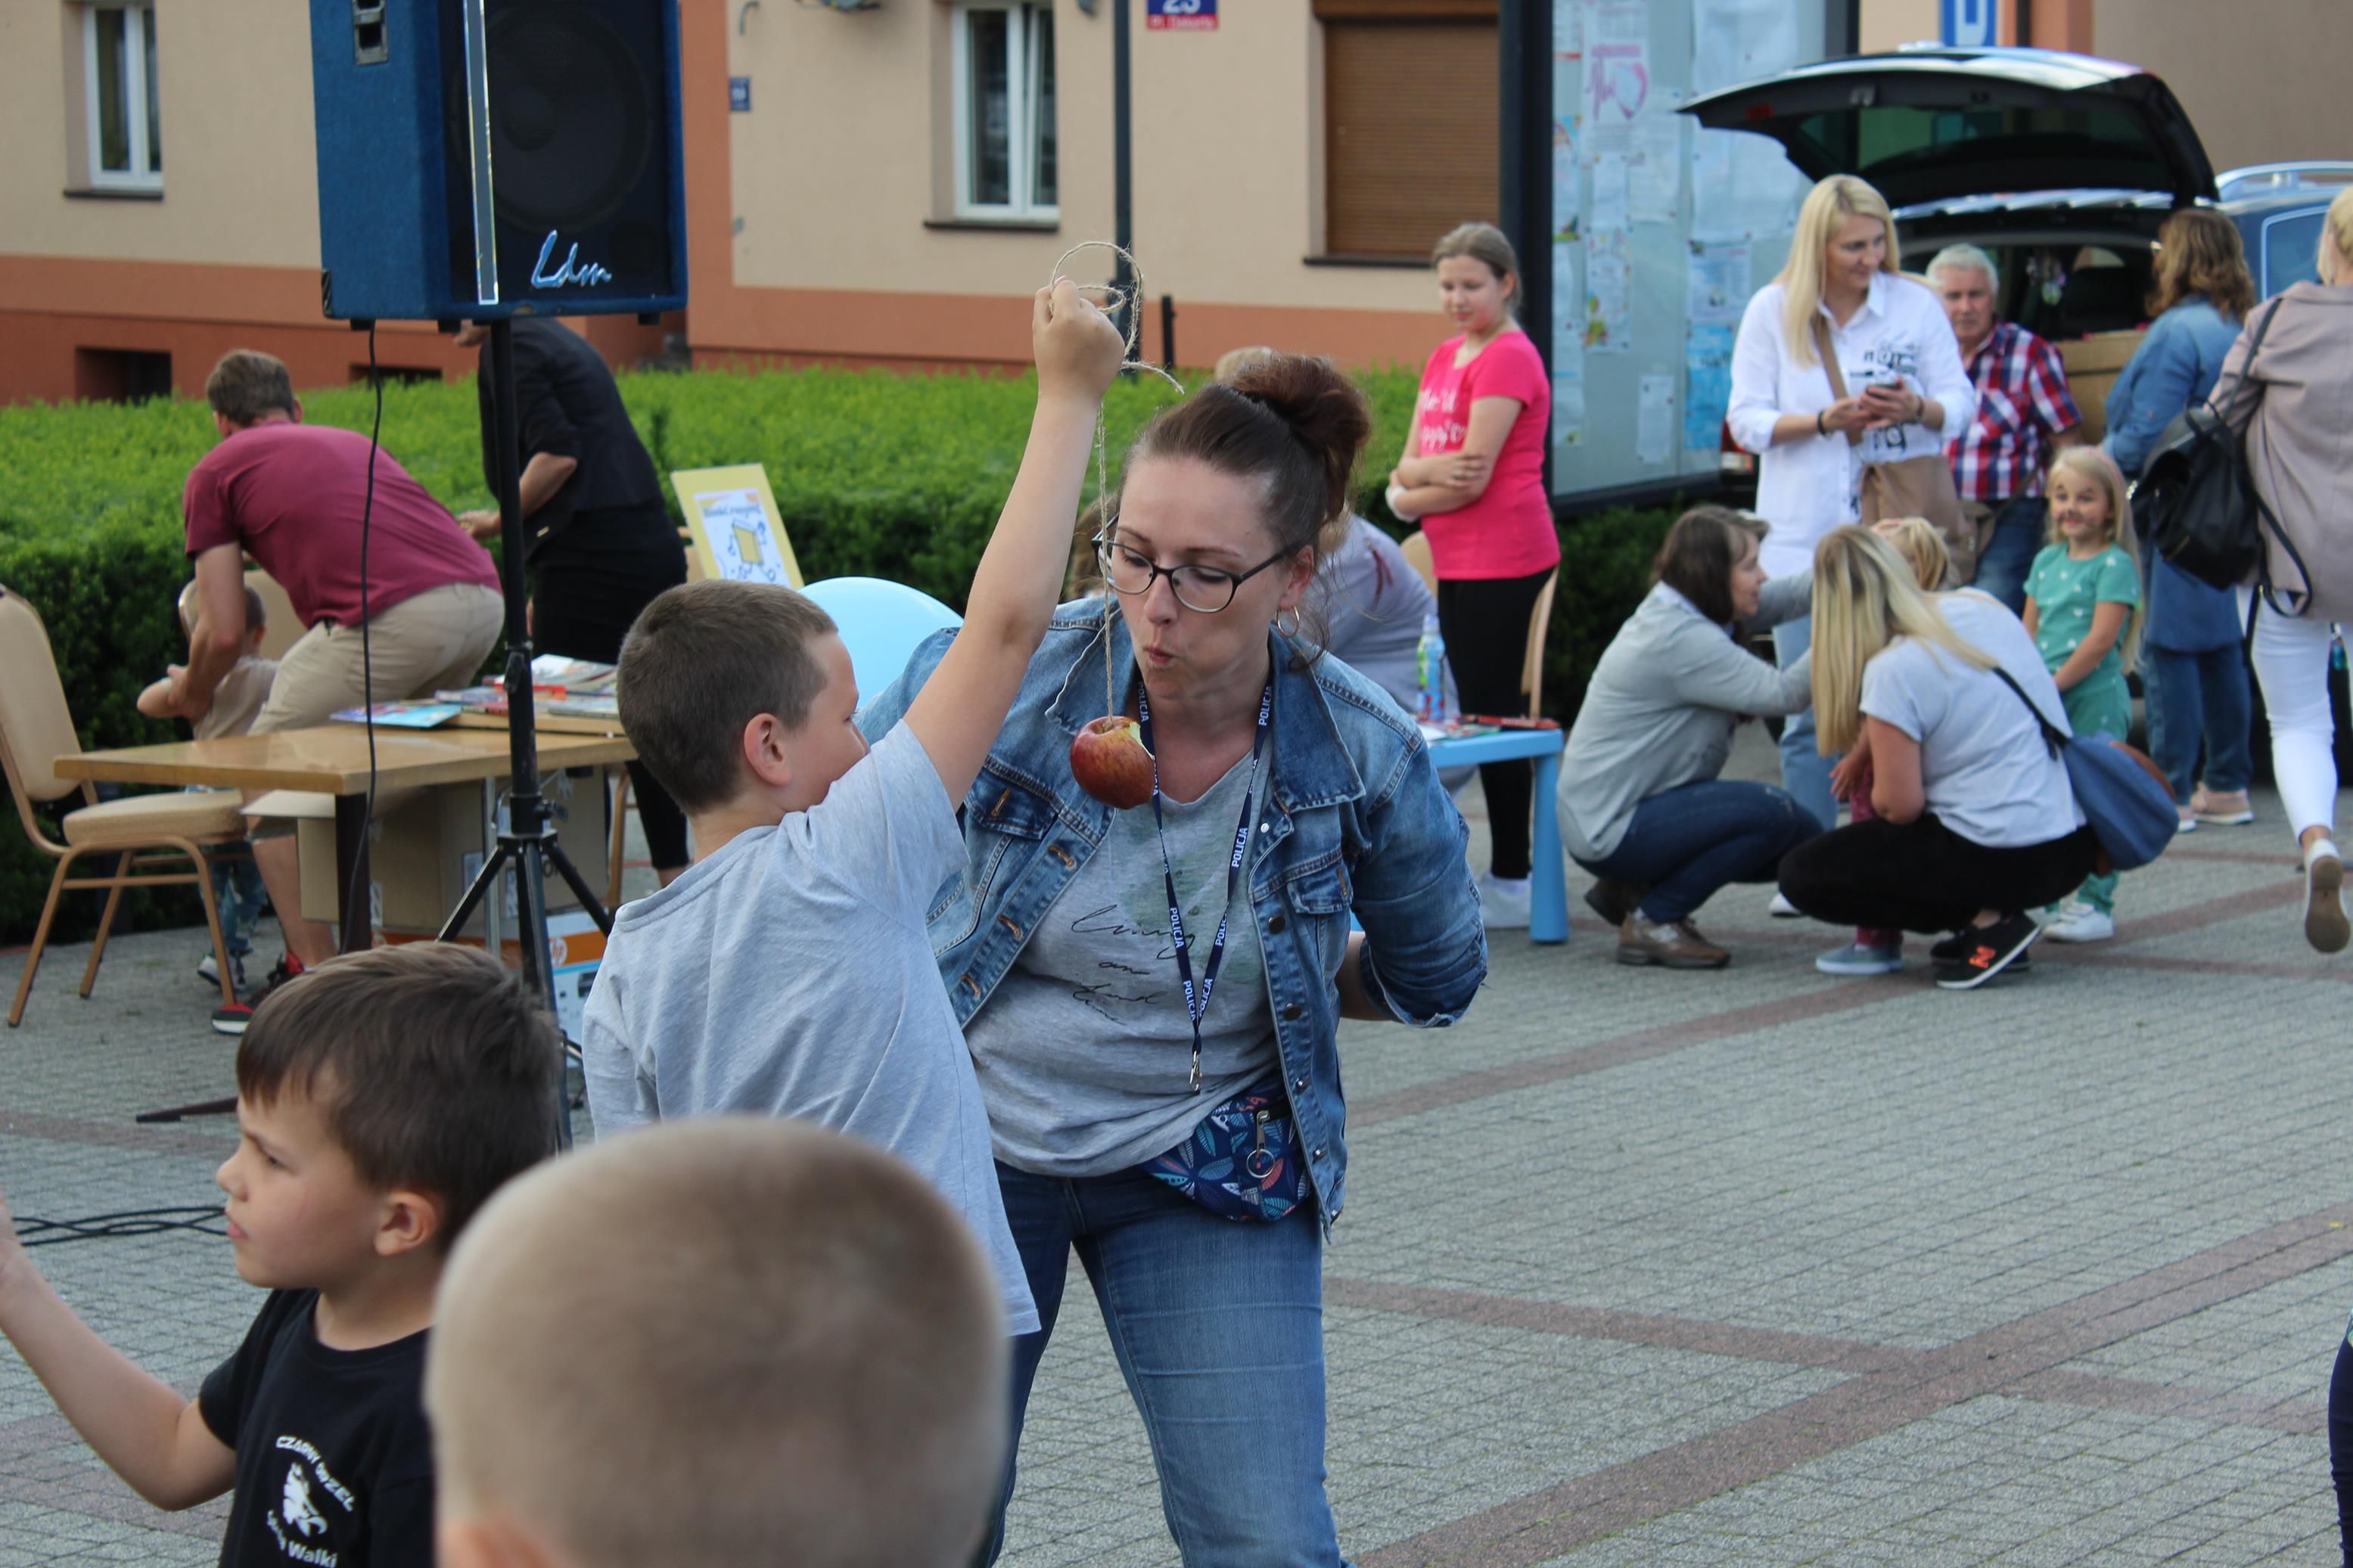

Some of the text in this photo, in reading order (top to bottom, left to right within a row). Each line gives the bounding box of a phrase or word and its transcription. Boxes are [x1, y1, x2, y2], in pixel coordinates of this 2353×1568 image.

[1138, 682, 1149, 722] POLICJA
[1231, 827, 1248, 868] POLICJA
[1170, 908, 1184, 949] POLICJA
[1214, 913, 1226, 947] POLIC
[1183, 980, 1196, 1021] POLICJA
